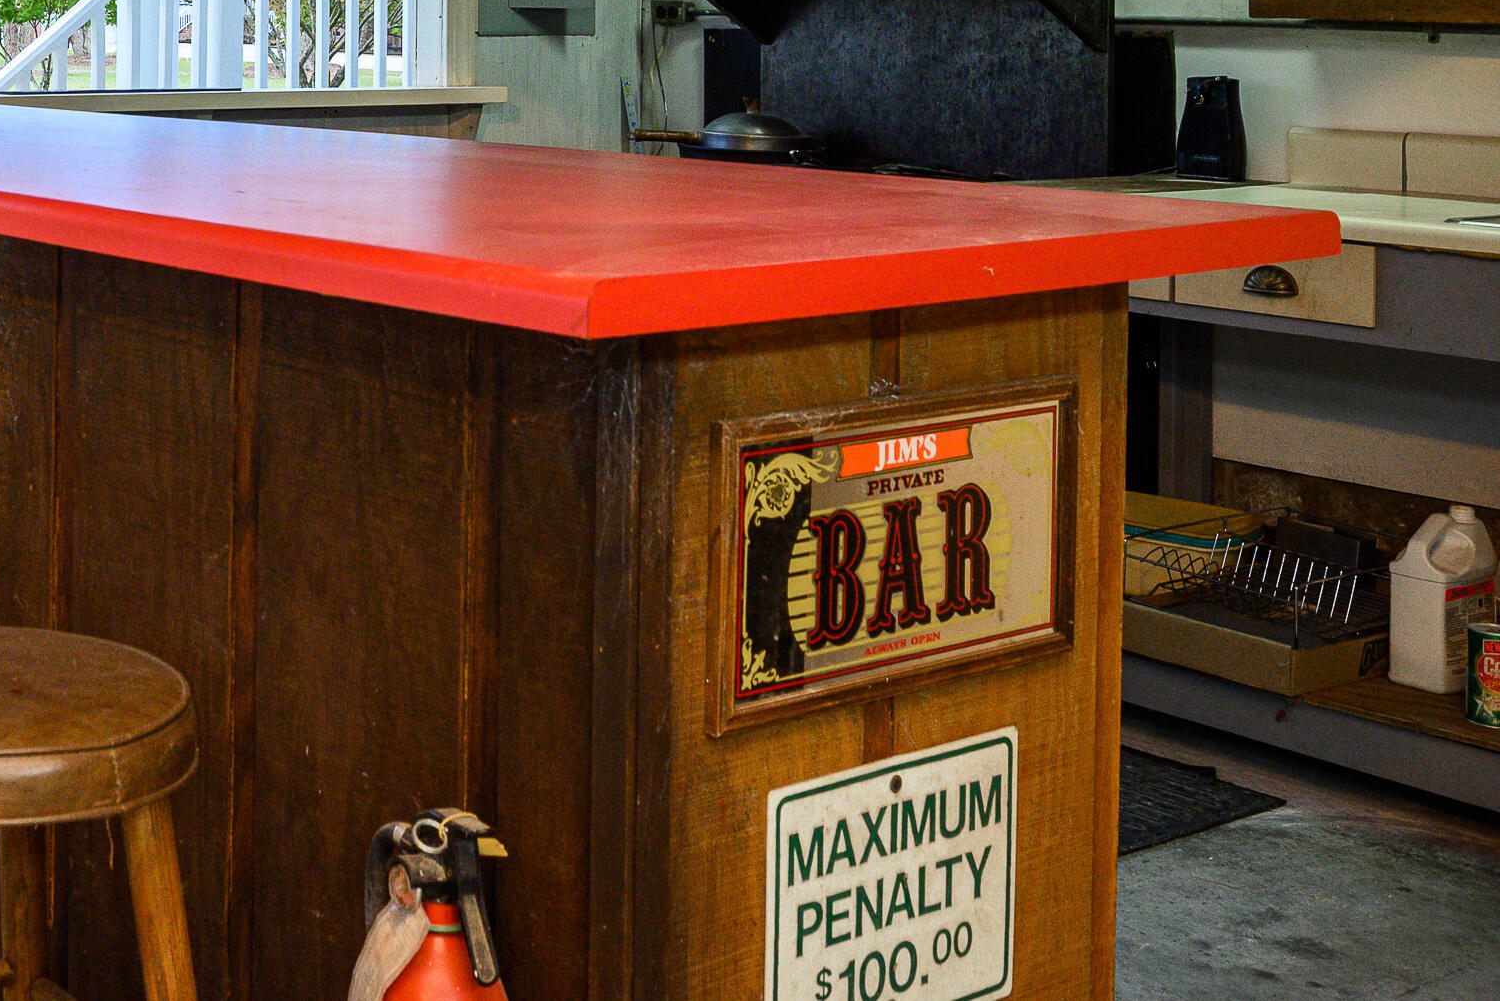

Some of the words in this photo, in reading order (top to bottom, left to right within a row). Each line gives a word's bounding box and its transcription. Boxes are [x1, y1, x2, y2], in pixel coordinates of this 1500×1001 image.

[866, 469, 945, 497] PRIVATE
[874, 434, 938, 472] JIM'S
[806, 482, 996, 649] BAR
[864, 636, 908, 657] ALWAYS
[910, 631, 941, 648] OPEN
[787, 774, 1002, 888] MAXIMUM
[796, 845, 993, 958] PENALTY
[815, 921, 973, 1001] $100.00
